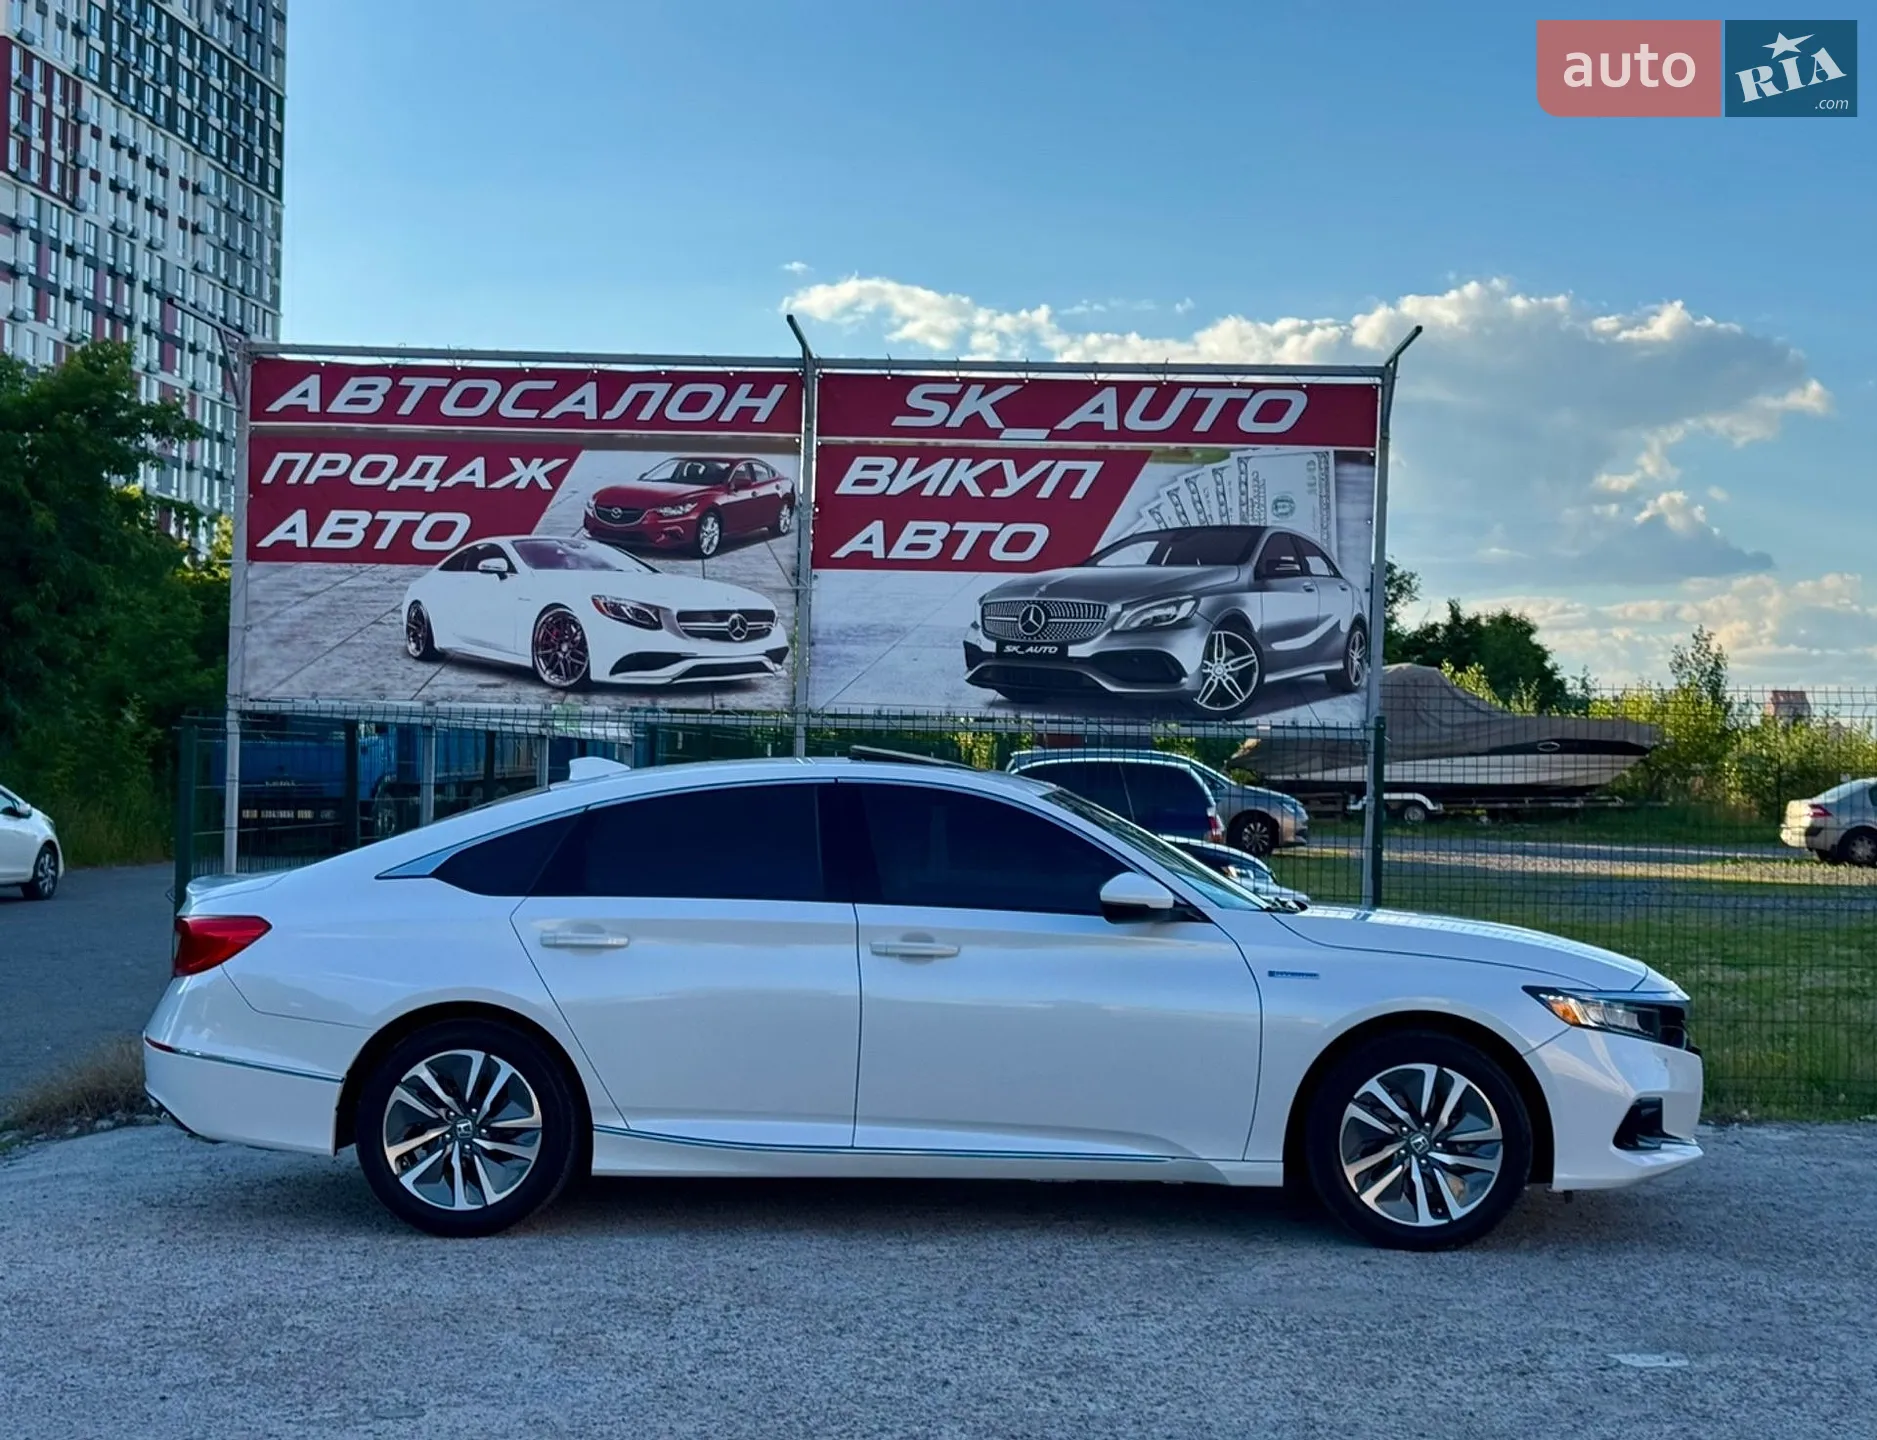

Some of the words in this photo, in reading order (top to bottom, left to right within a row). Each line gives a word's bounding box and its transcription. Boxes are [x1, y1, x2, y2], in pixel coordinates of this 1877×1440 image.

[264, 374, 789, 423] АВТОСАЛОН
[892, 383, 1308, 440] SK_AUTO
[261, 452, 568, 492] ПРОДАЖ
[835, 456, 1104, 499] ВИКУП
[256, 509, 471, 551] АВТО
[831, 519, 1050, 562] АВТО
[1003, 645, 1058, 654] SK_AUTO
